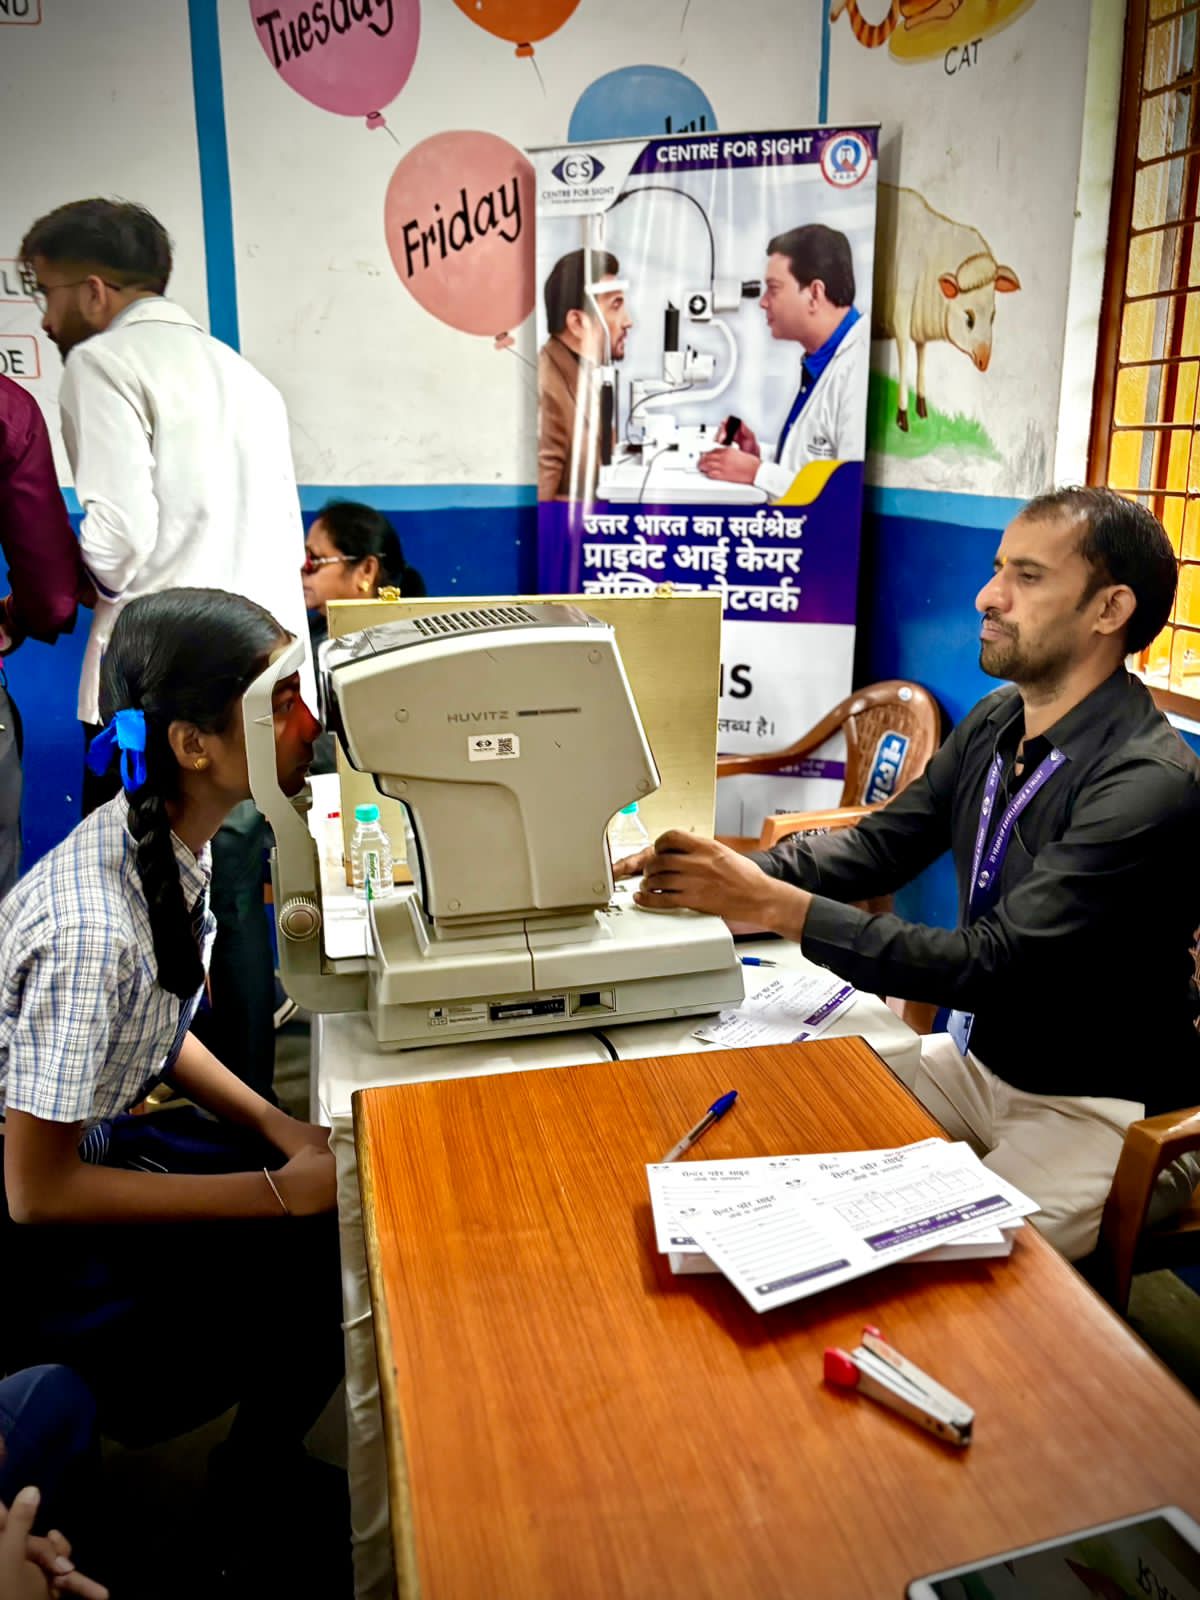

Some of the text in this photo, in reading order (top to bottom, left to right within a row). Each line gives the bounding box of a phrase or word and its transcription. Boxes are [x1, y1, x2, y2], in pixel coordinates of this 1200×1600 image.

[256, 0, 394, 69] Tuesday
[944, 38, 983, 76] CAT
[655, 136, 814, 163] CENTRE FOR SIGHT
[565, 161, 591, 178] CS
[542, 188, 571, 200] CENTRE
[574, 187, 589, 197] FOR
[402, 176, 522, 278] Friday
[582, 513, 630, 535] उत्तर
[633, 514, 689, 537] भारत
[692, 515, 725, 538] का
[582, 534, 803, 575] प्राइवेट आई केयर
[446, 710, 510, 724] HUVITZ
